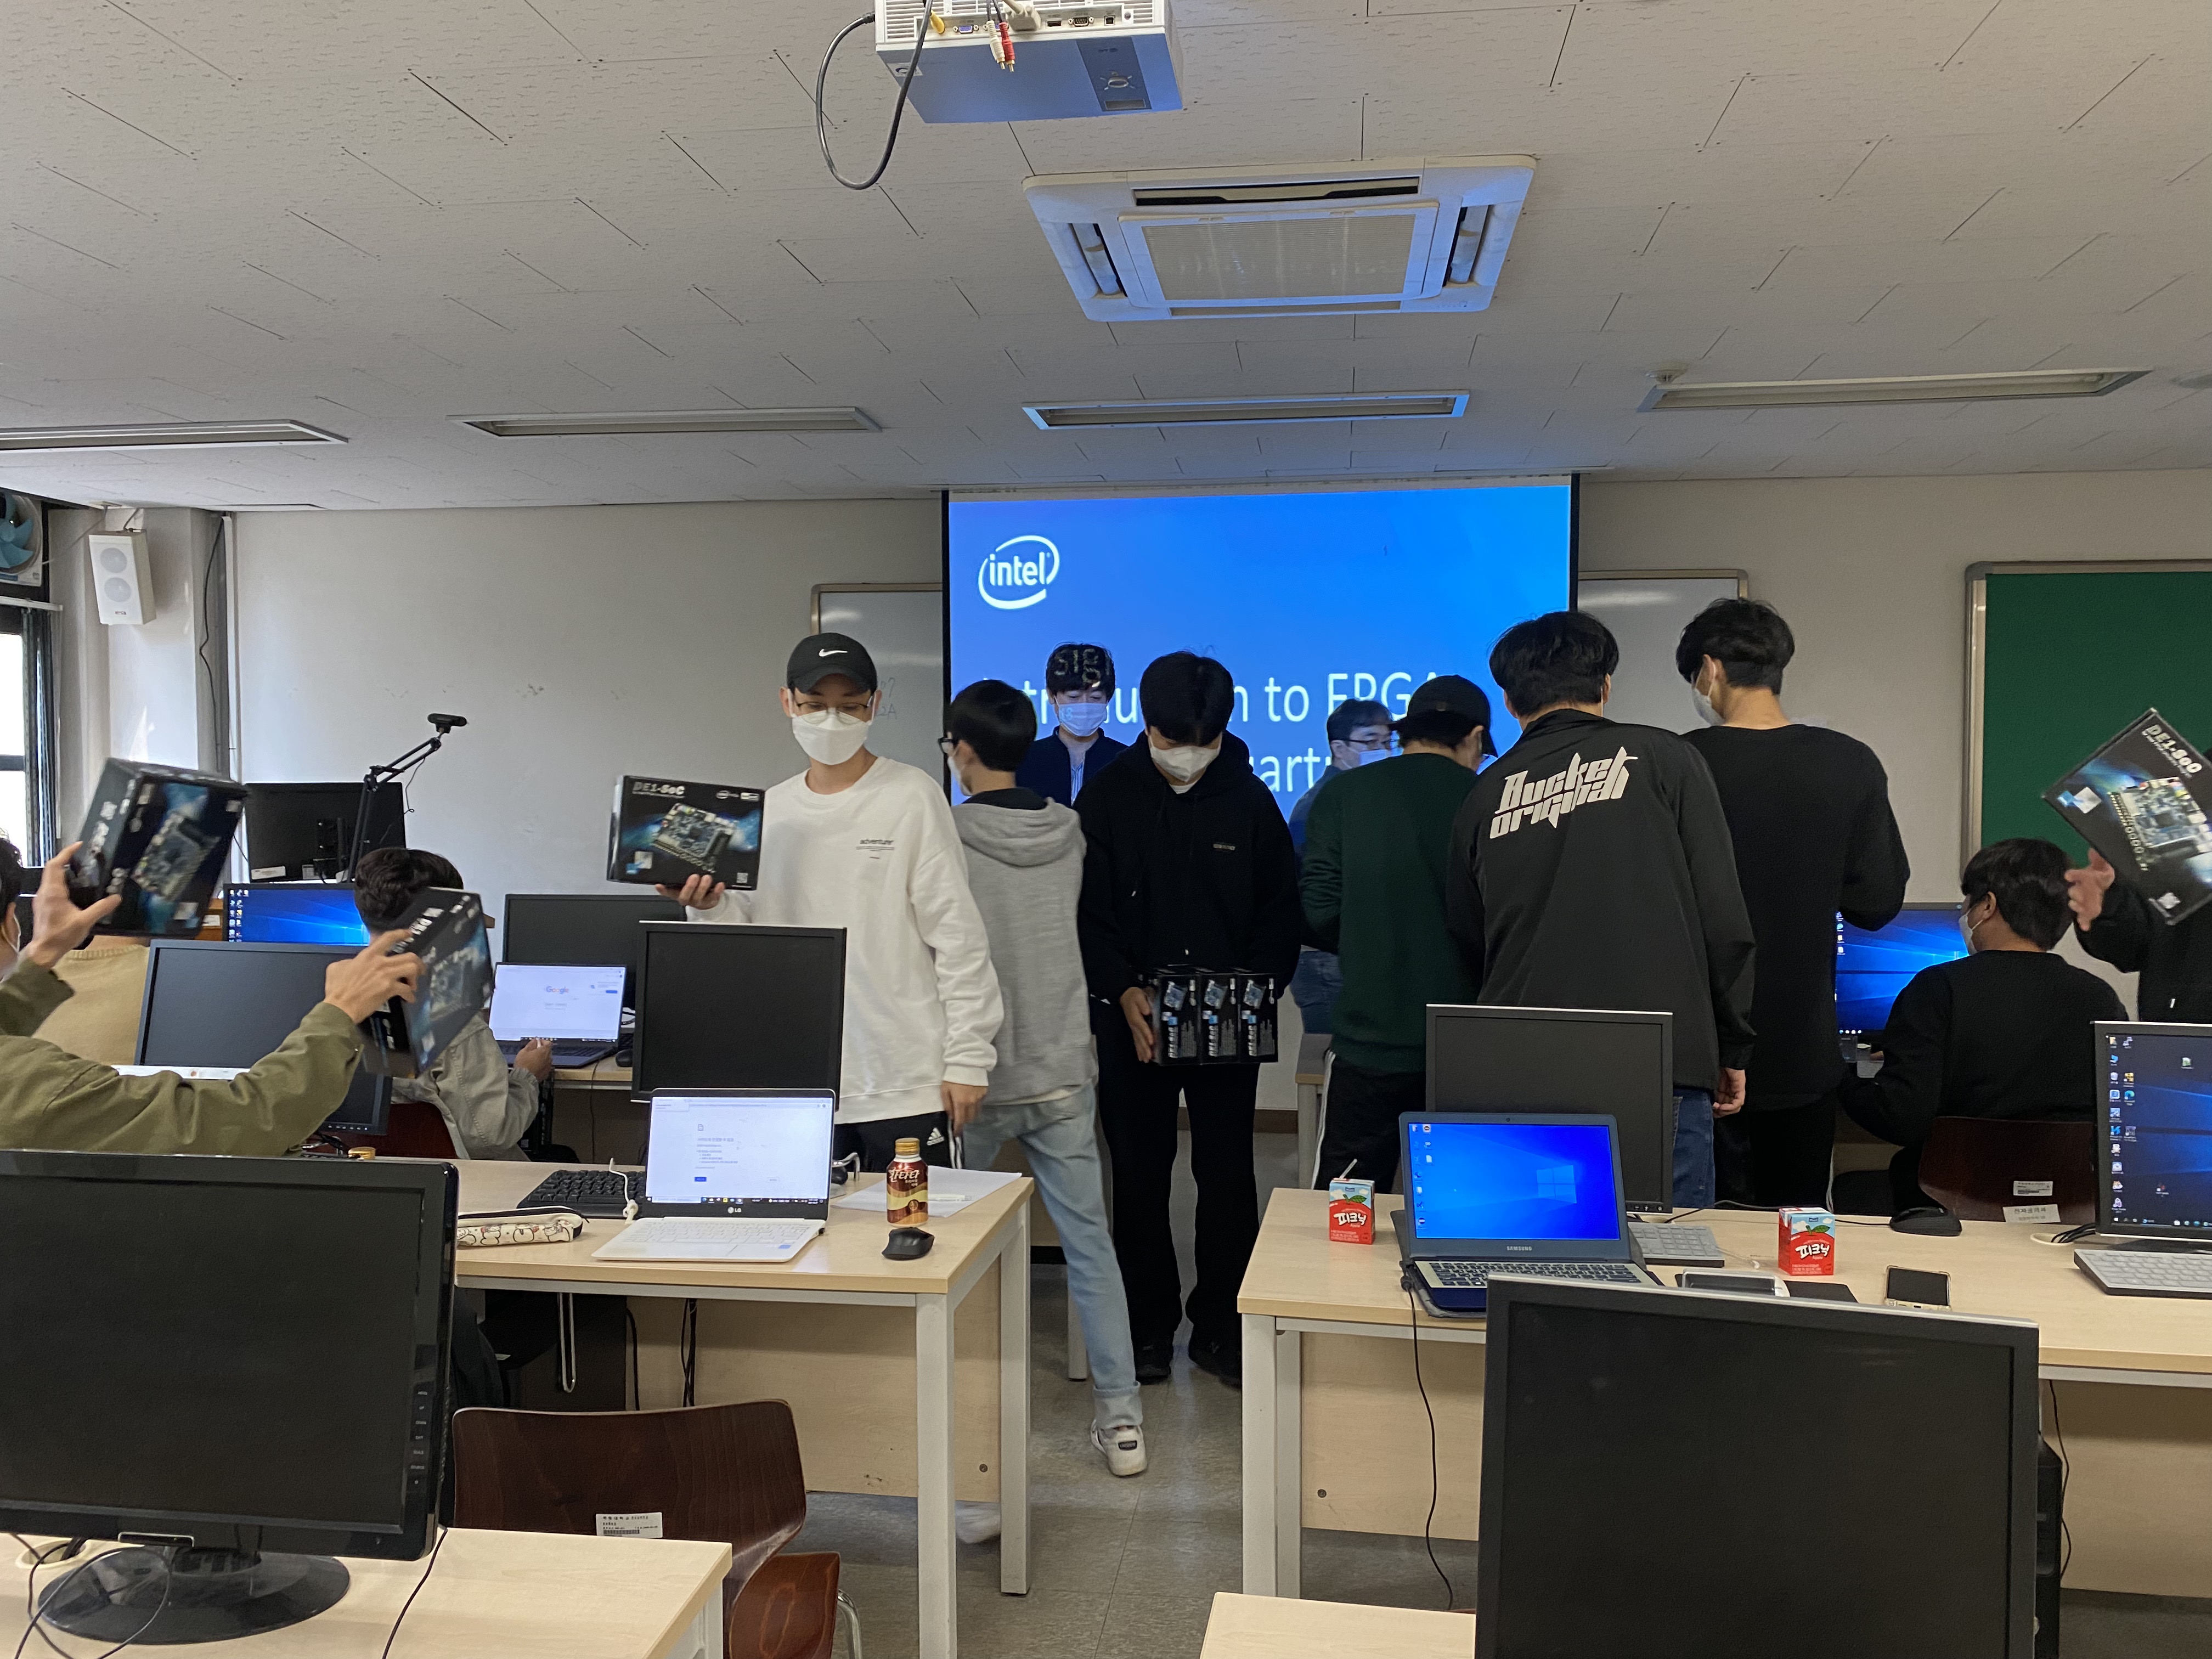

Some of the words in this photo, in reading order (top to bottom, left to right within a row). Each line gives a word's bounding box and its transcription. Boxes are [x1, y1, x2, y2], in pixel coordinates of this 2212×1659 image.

[989, 551, 1045, 586] intel
[1265, 678, 1310, 723] to
[1328, 672, 1438, 720] FPG
[1333, 1212, 1367, 1226] 피크닉
[1795, 1243, 1830, 1259] 피크닉
